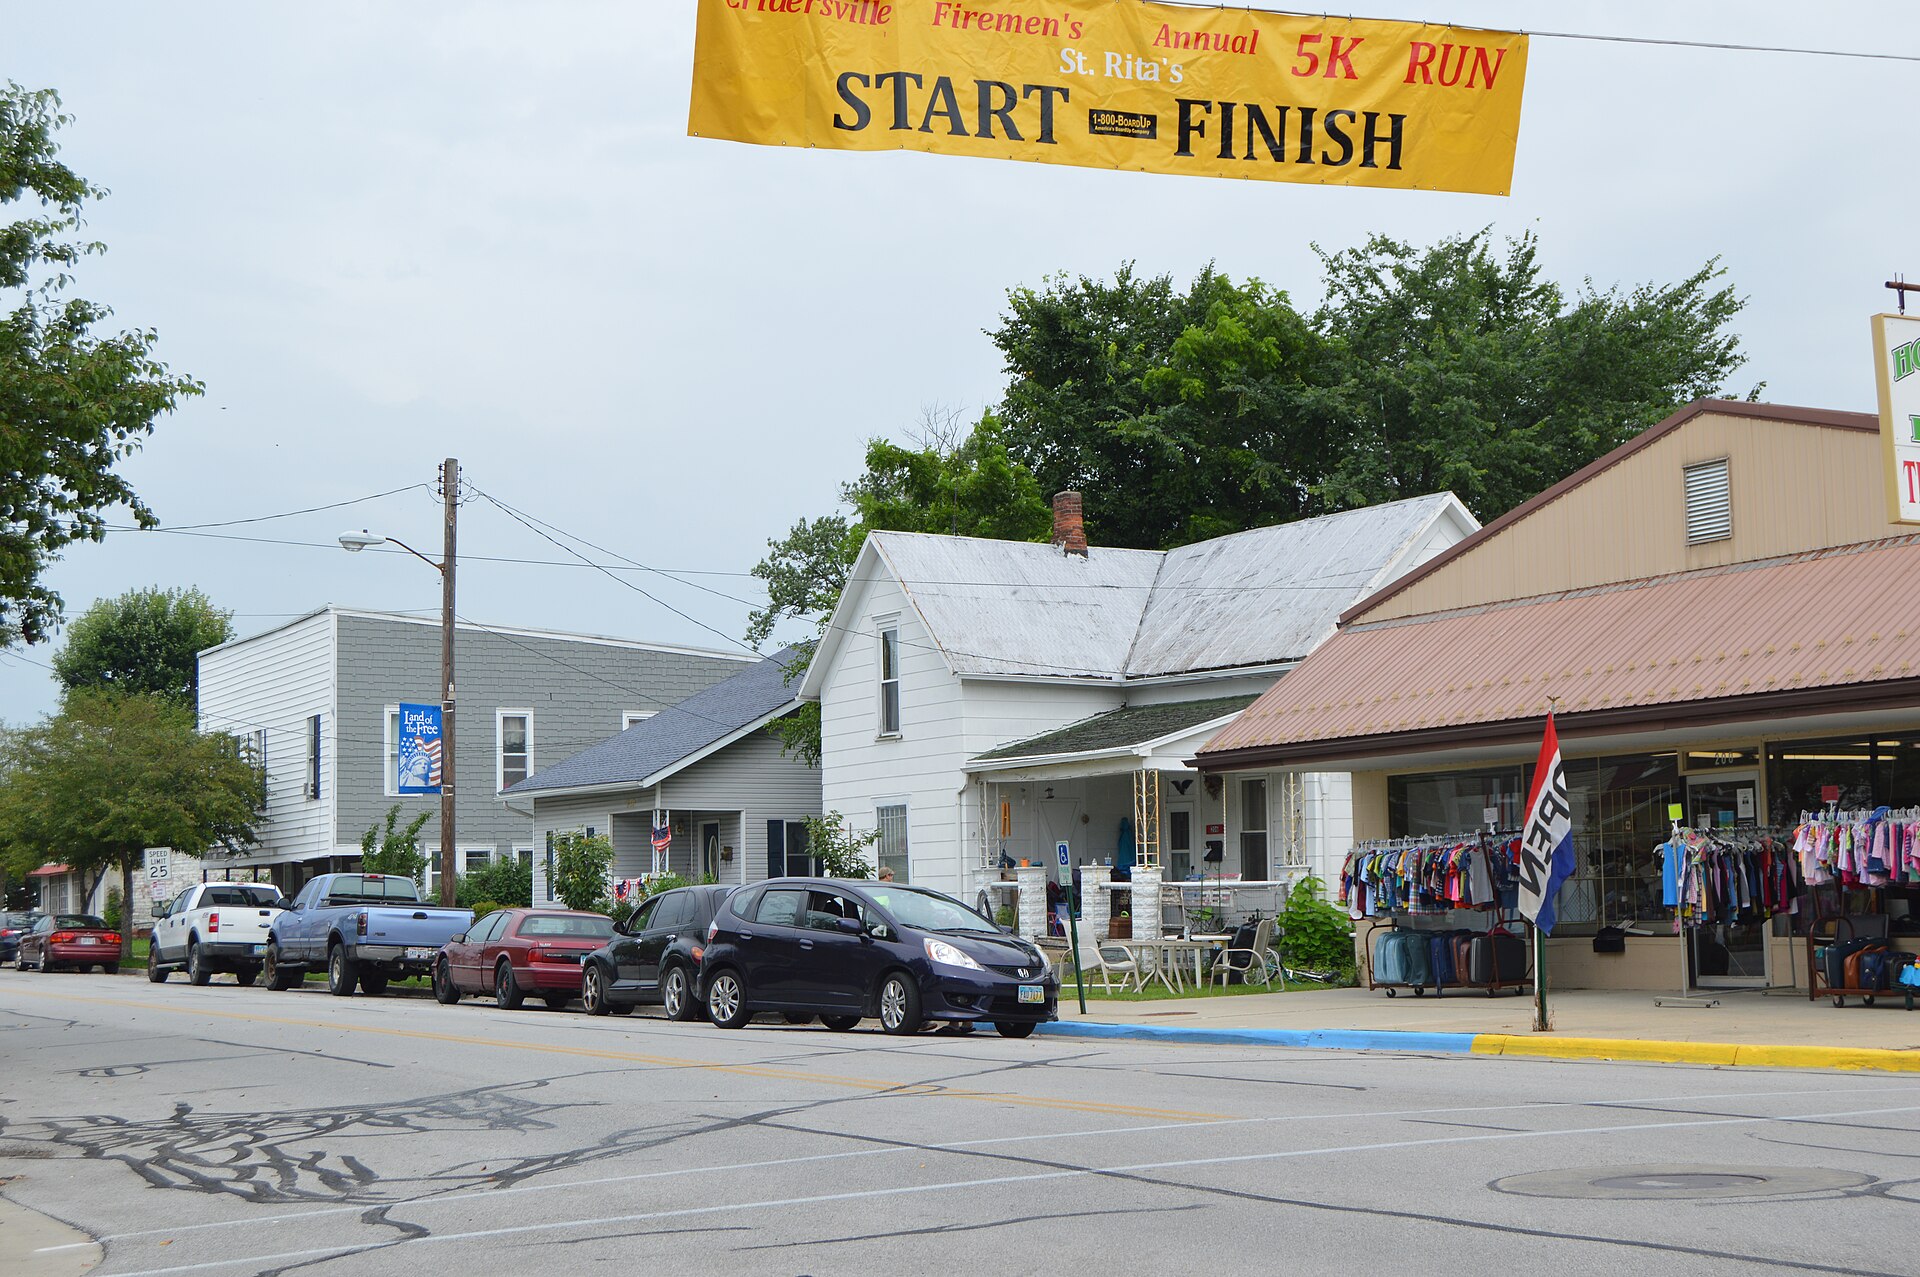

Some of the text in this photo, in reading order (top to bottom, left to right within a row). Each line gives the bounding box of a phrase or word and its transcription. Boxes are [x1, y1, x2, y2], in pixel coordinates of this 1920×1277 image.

[932, 1, 1083, 40] Firemen's
[1152, 23, 1260, 55] Annual
[1291, 33, 1364, 80] 5K
[1403, 41, 1507, 90] RUN
[1059, 47, 1184, 83] St. Rita's
[833, 71, 1407, 170] START FINISH
[404, 711, 433, 724] Land of
[406, 722, 438, 735] the Free
[150, 866, 168, 878] 25
